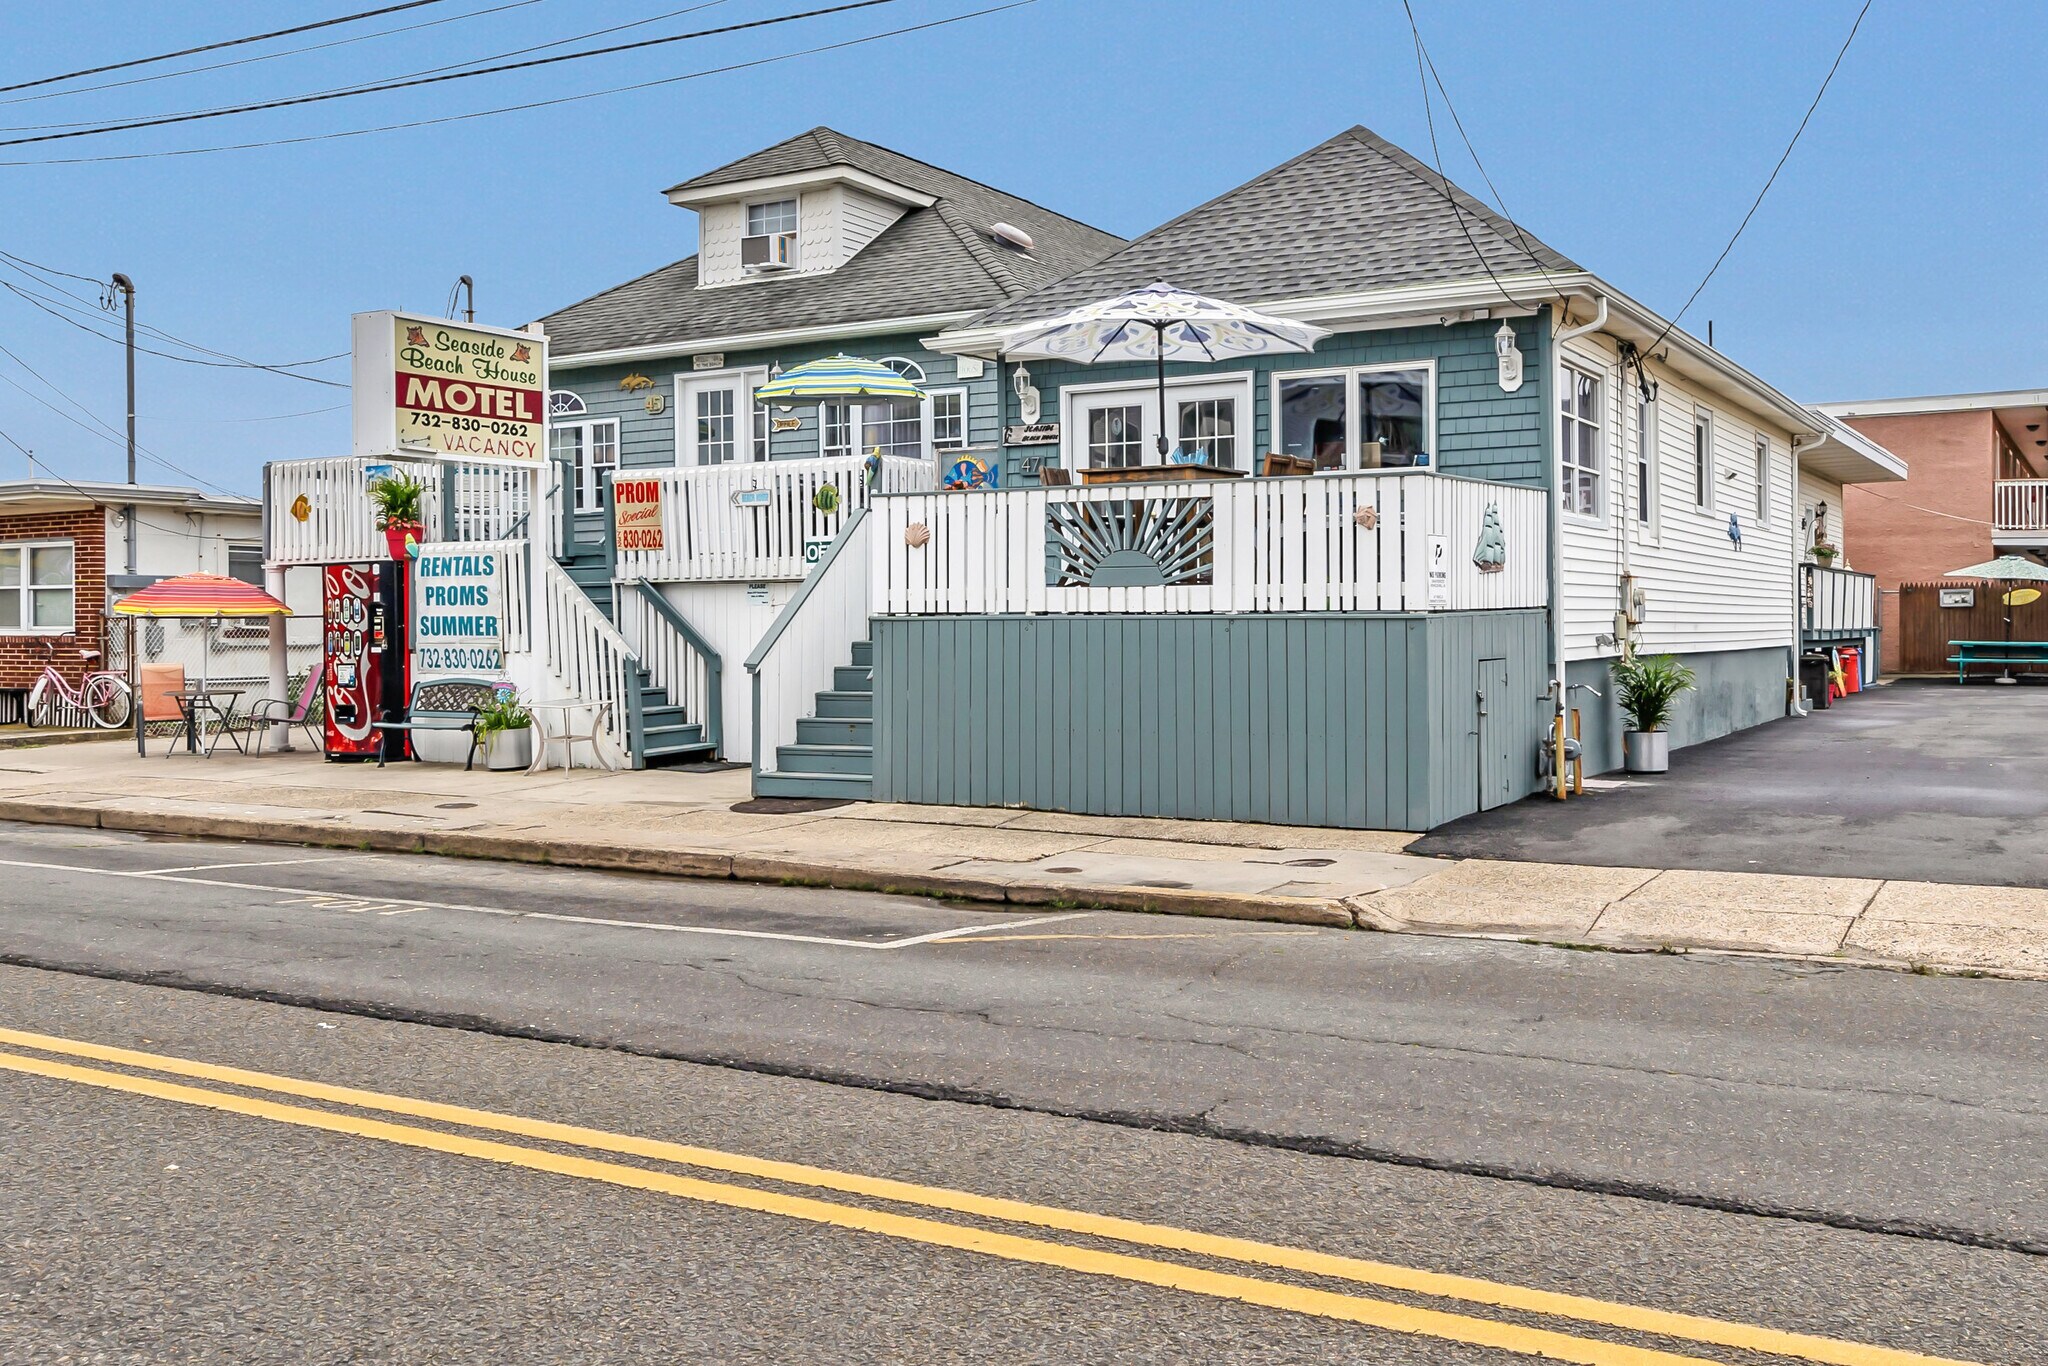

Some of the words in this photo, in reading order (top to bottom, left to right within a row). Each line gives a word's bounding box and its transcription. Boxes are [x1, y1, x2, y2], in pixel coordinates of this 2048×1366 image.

[435, 331, 505, 359] Seaside
[400, 347, 464, 374] Beach
[472, 358, 537, 385] House
[405, 377, 533, 420] MOTEL
[411, 411, 528, 438] 732-830-0262
[1024, 424, 1054, 433] SEASIDE
[443, 433, 537, 459] VACANCY
[1021, 456, 1040, 473] 47
[616, 481, 659, 504] PROM
[618, 504, 659, 526] Special
[623, 529, 663, 549] 830-0262
[420, 554, 495, 577] RENTALS
[425, 584, 489, 607] PROMS
[420, 615, 498, 637] SUMMER
